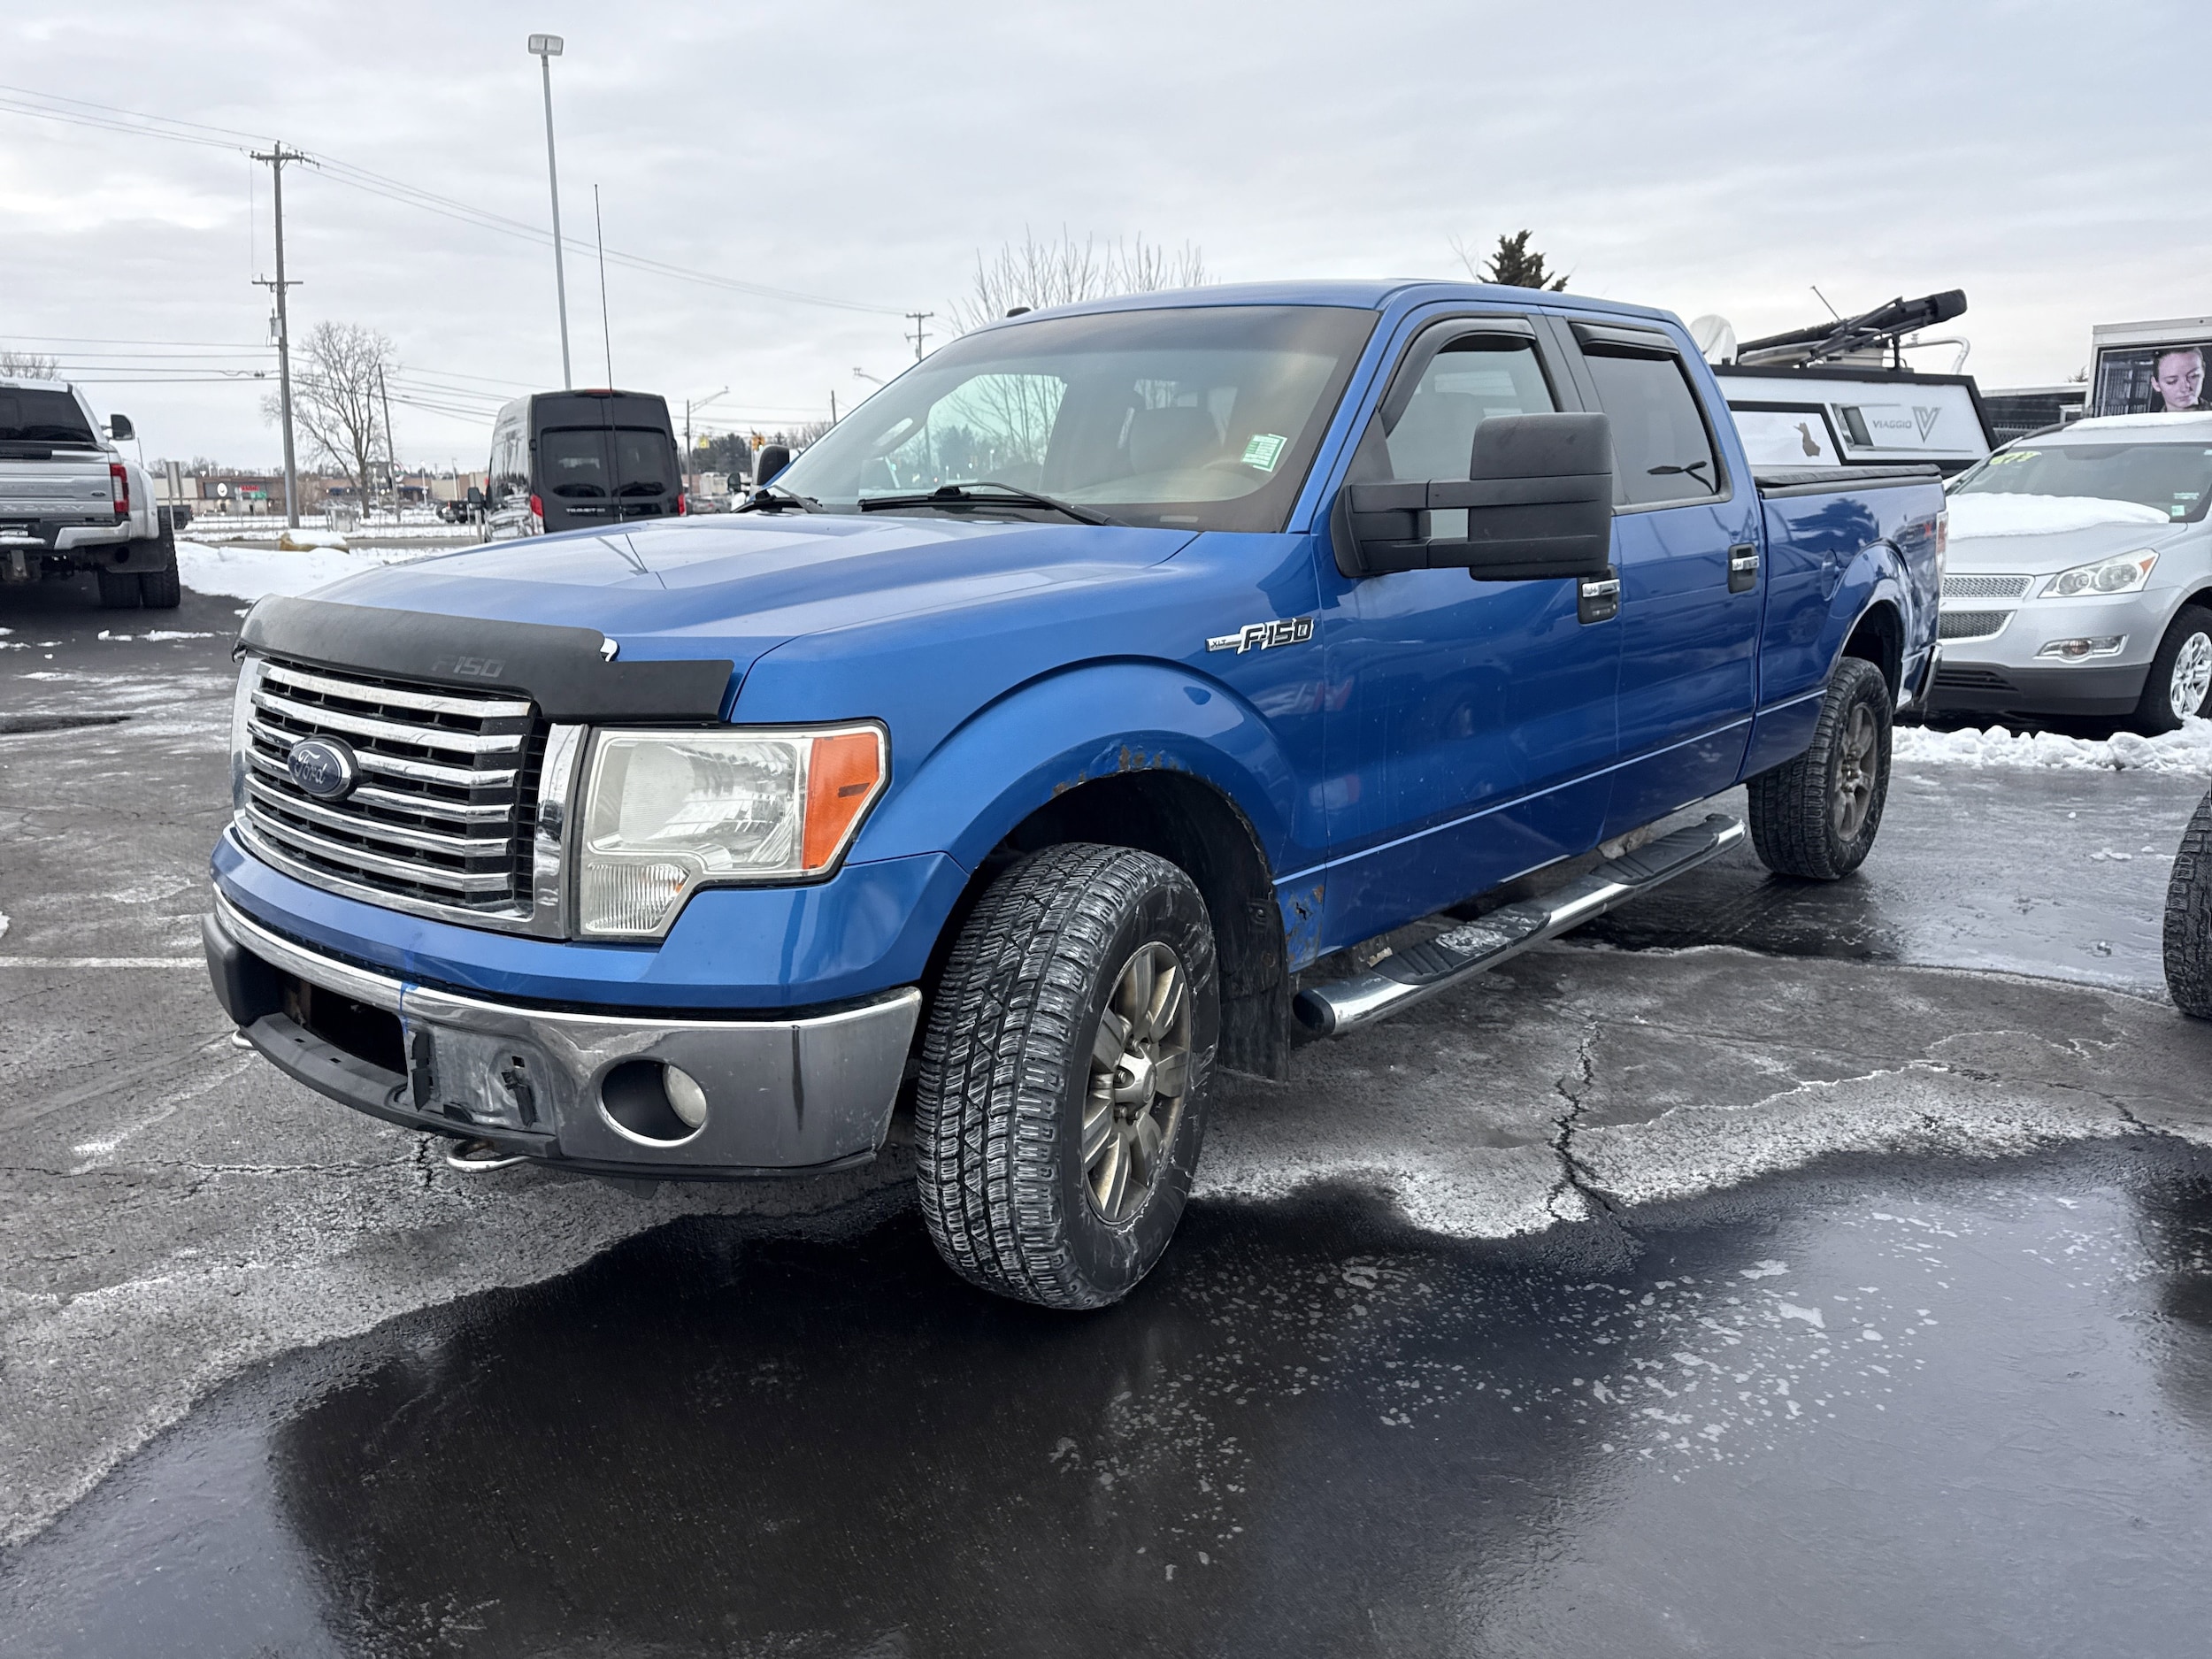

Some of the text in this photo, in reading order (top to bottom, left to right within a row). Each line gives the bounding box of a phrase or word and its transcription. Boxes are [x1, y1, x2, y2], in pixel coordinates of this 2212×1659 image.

[1872, 419, 1912, 429] VIAGGIO
[1210, 639, 1226, 649] XLT
[294, 749, 328, 785] Ford
